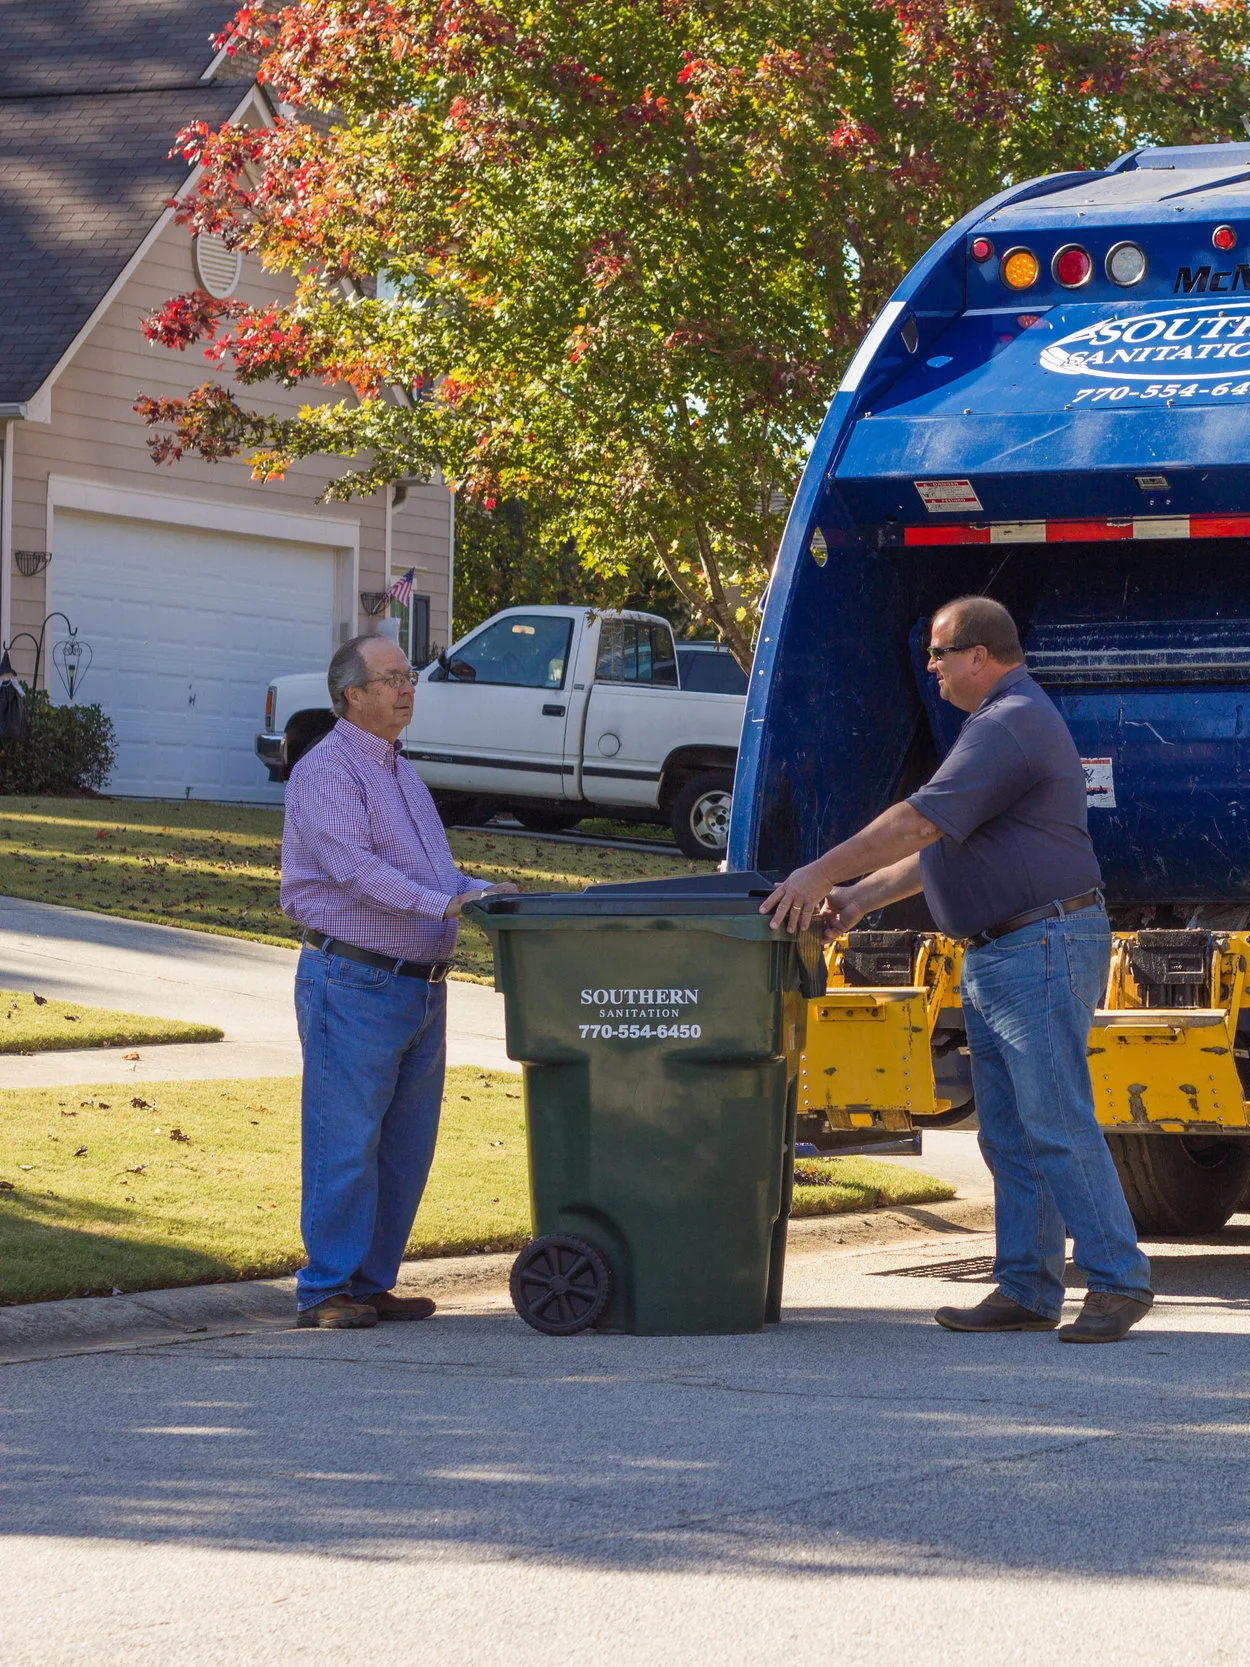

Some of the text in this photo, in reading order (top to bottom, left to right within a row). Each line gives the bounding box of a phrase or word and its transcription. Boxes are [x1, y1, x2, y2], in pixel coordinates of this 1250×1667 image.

[580, 989, 699, 1005] SOUTHERN
[599, 1008, 679, 1018] SANITATION
[578, 1024, 702, 1039] 770-554-6450
